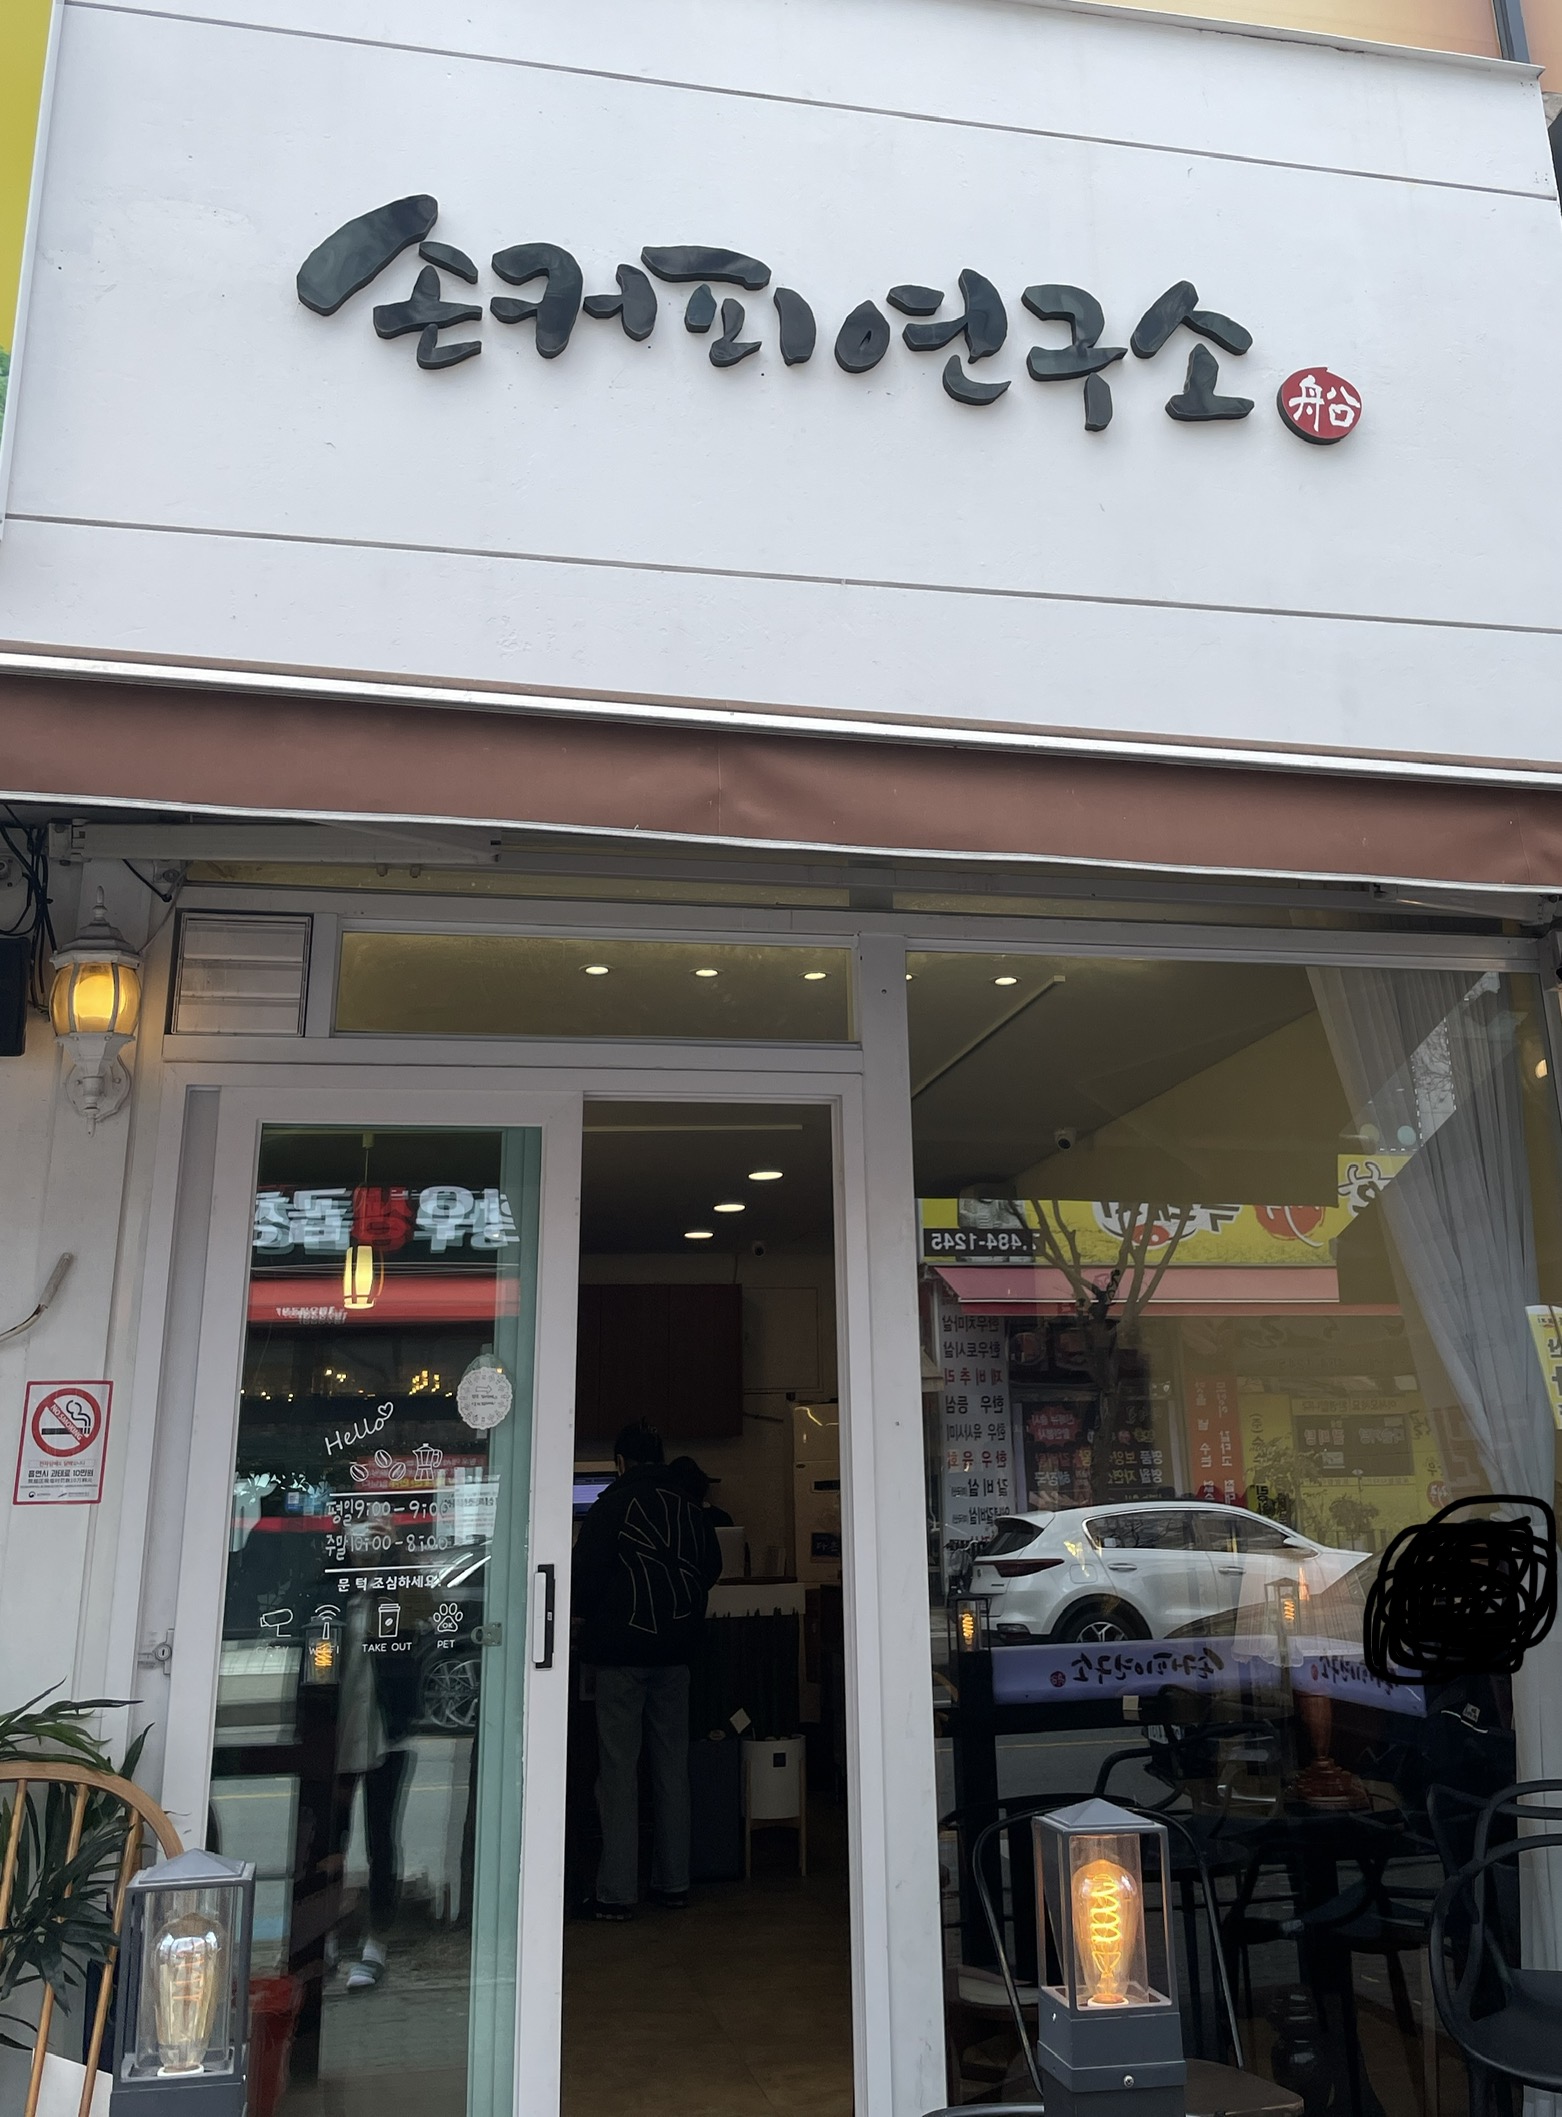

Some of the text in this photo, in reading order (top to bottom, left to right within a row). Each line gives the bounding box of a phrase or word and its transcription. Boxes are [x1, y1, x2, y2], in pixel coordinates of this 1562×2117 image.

[296, 194, 1256, 432] 손커피연구소
[324, 1417, 386, 1456] Hello
[362, 1642, 413, 1653] TAKE OUT
[436, 1640, 456, 1649] PET
